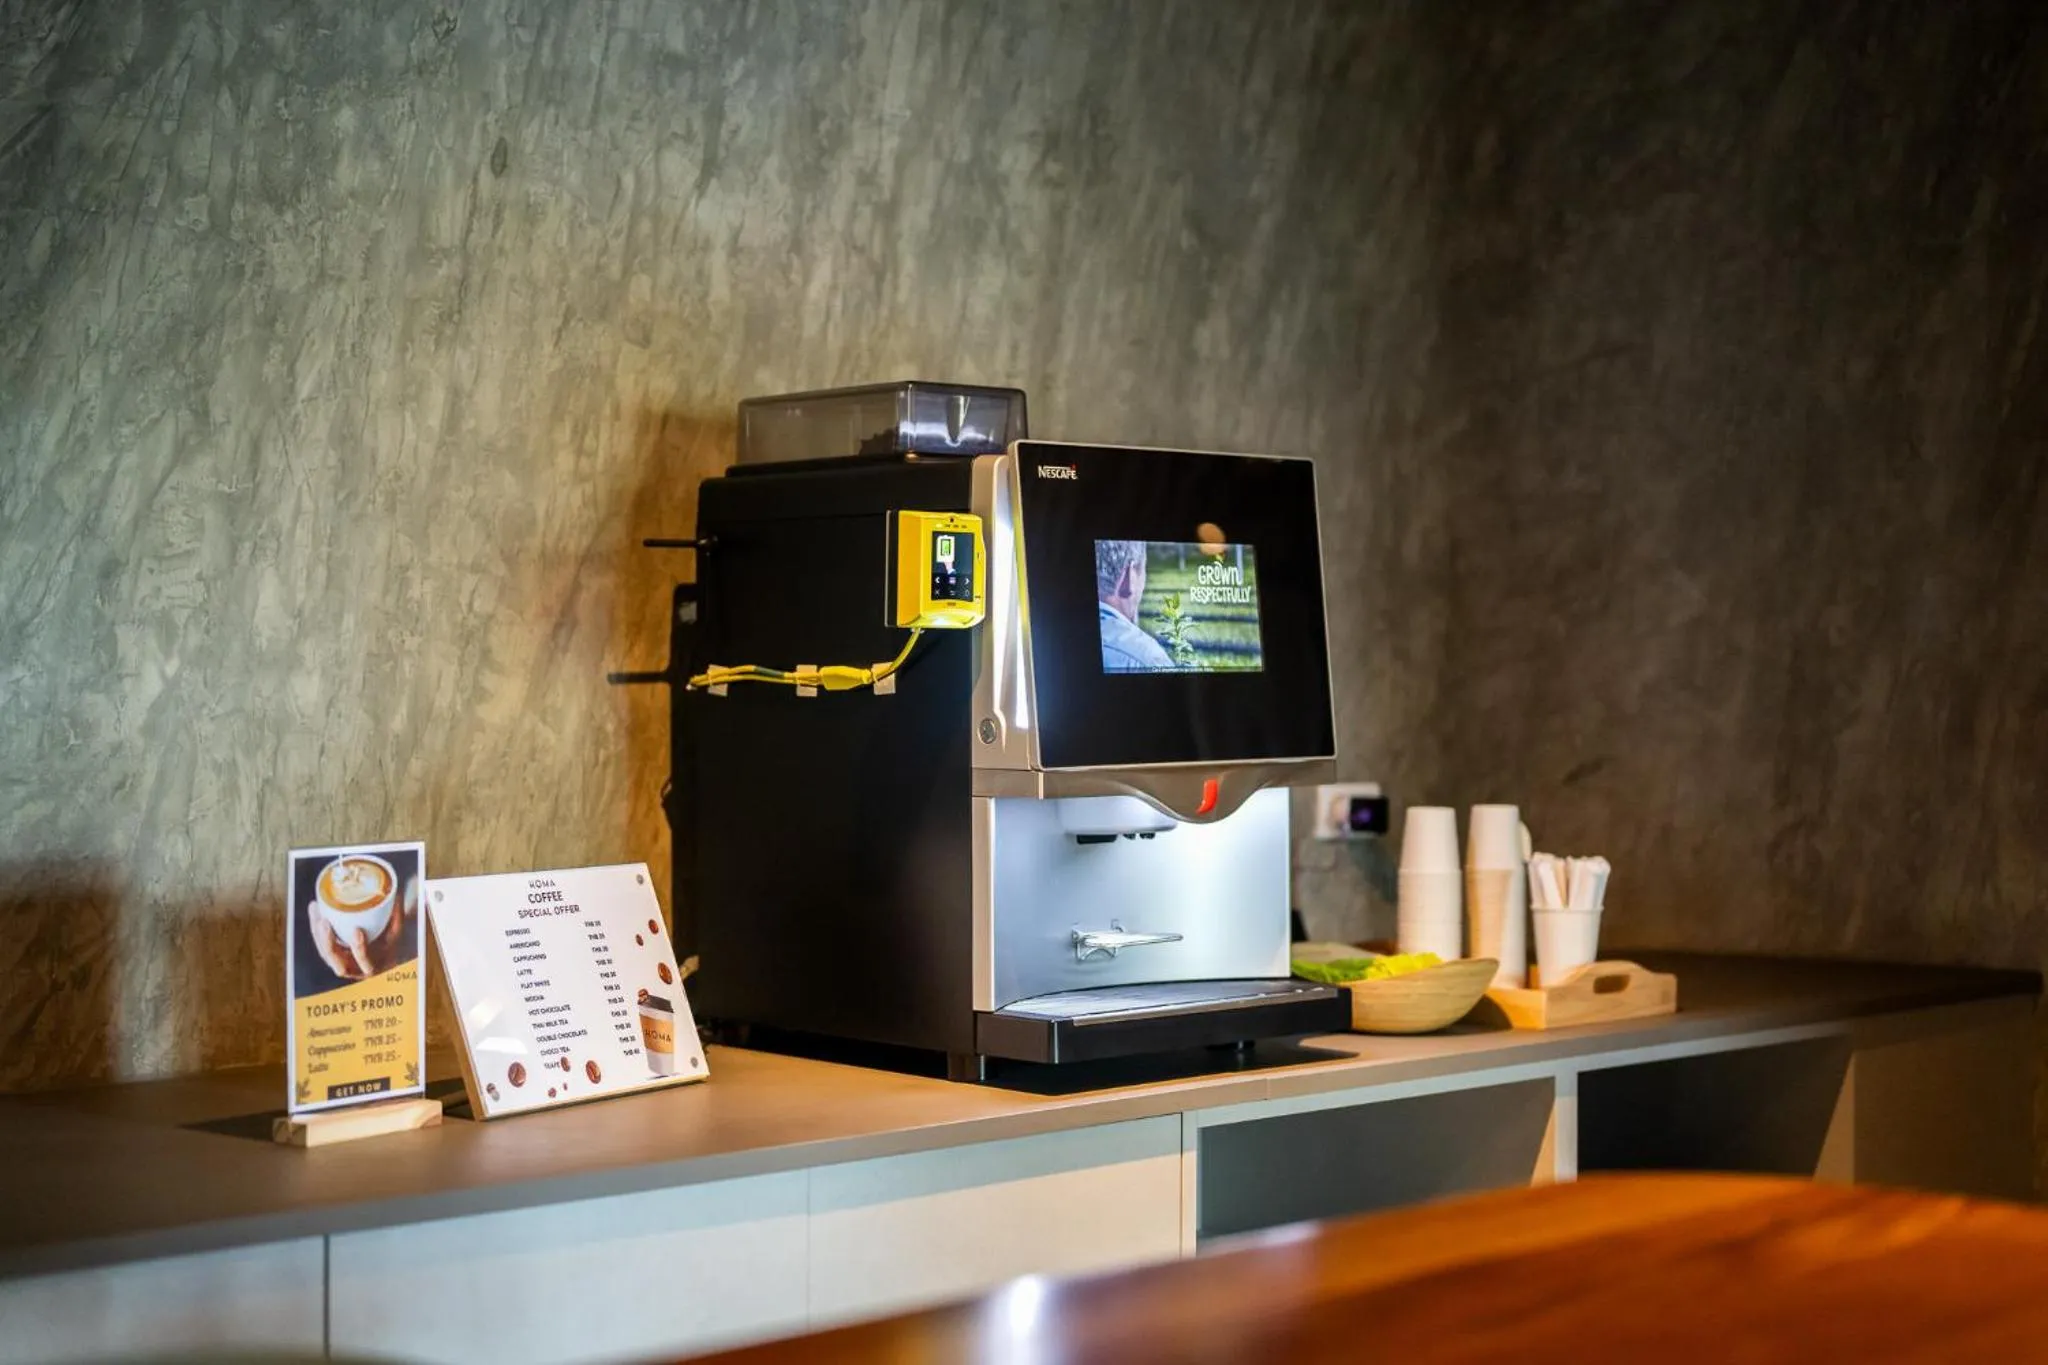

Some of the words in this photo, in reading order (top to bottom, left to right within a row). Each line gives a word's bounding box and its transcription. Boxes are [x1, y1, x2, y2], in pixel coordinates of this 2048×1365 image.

[1198, 561, 1243, 585] GROWN
[1190, 586, 1251, 604] RESPECTFULLY
[528, 891, 564, 904] COFFEE
[517, 907, 552, 919] SPECIAL
[554, 904, 580, 915] OFFER
[510, 940, 541, 949] AMERICANO
[516, 968, 532, 976] LATTE
[533, 980, 550, 988] WHITE
[524, 995, 545, 1003] MOCHA
[306, 1000, 357, 1018] TODAY'S
[361, 995, 404, 1011] PROMO
[528, 1008, 540, 1016] HOT
[540, 1004, 571, 1015] CHOCOLATE
[532, 1022, 545, 1030] THAI
[545, 1020, 558, 1028] MILK
[558, 1019, 569, 1027] TEA
[536, 1034, 557, 1044] DOUBLE
[558, 1029, 588, 1041] CHOCOLATE
[645, 1028, 671, 1042] HOMA
[540, 1048, 559, 1056] CHOCO
[335, 1086, 354, 1098] GET
[358, 1082, 381, 1094] NOW
